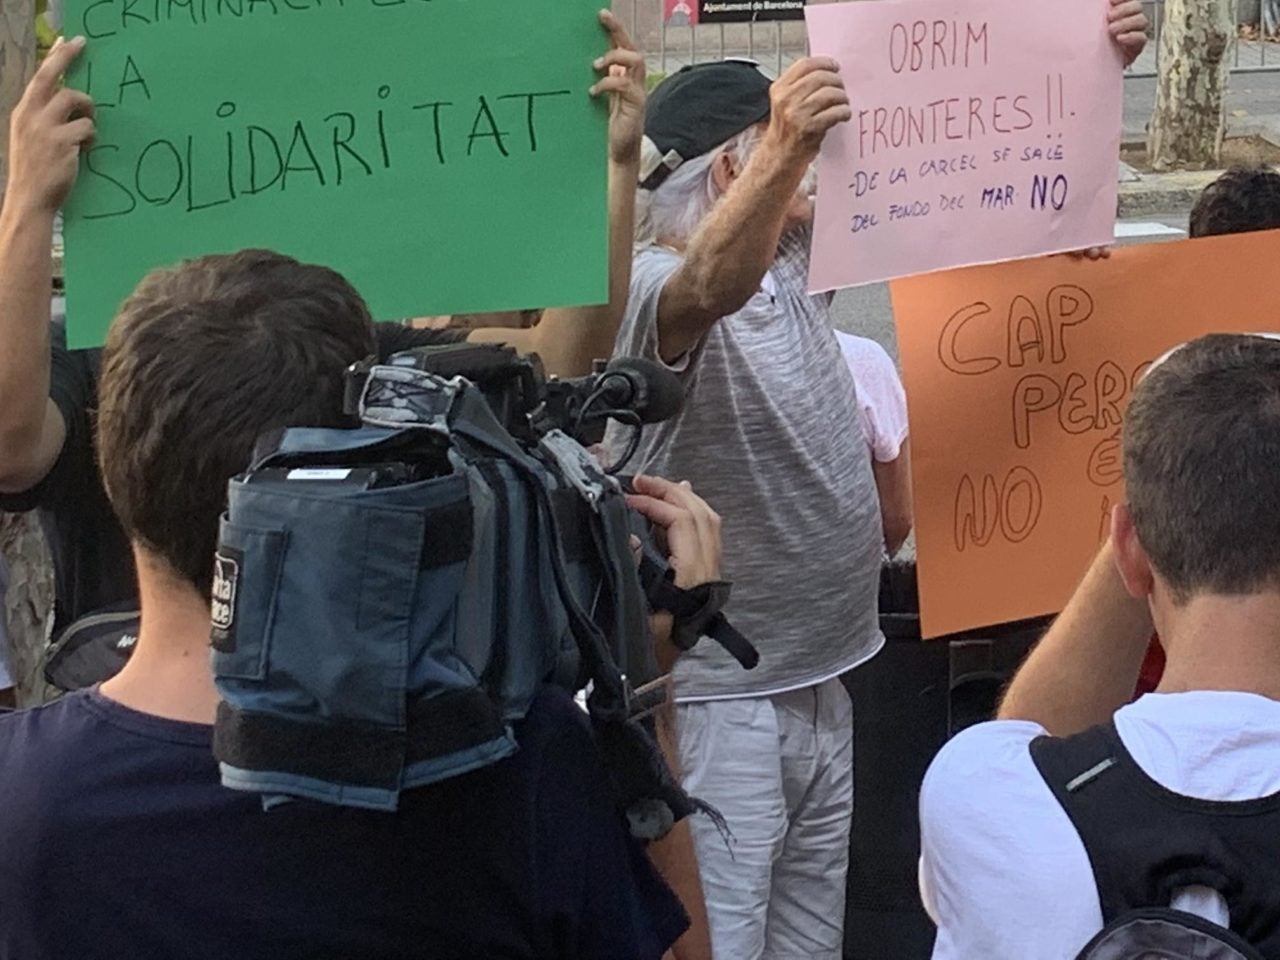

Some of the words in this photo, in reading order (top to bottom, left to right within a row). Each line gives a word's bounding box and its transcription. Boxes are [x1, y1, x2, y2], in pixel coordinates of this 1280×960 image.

[752, 1, 764, 11] de
[764, 0, 803, 10] Barcelona
[889, 20, 989, 74] OBRIM
[84, 54, 151, 109] LA
[889, 167, 908, 185] LA
[919, 154, 978, 177] CARCEL
[1020, 144, 1064, 162] SALE
[851, 213, 879, 233] DEL
[889, 200, 931, 222] FONDO
[938, 193, 966, 212] DEL
[980, 184, 1015, 210] MAR
[1030, 173, 1069, 211] NO
[937, 284, 1094, 376] CAP
[1012, 360, 1154, 449] PER
[953, 465, 1043, 553] NO
